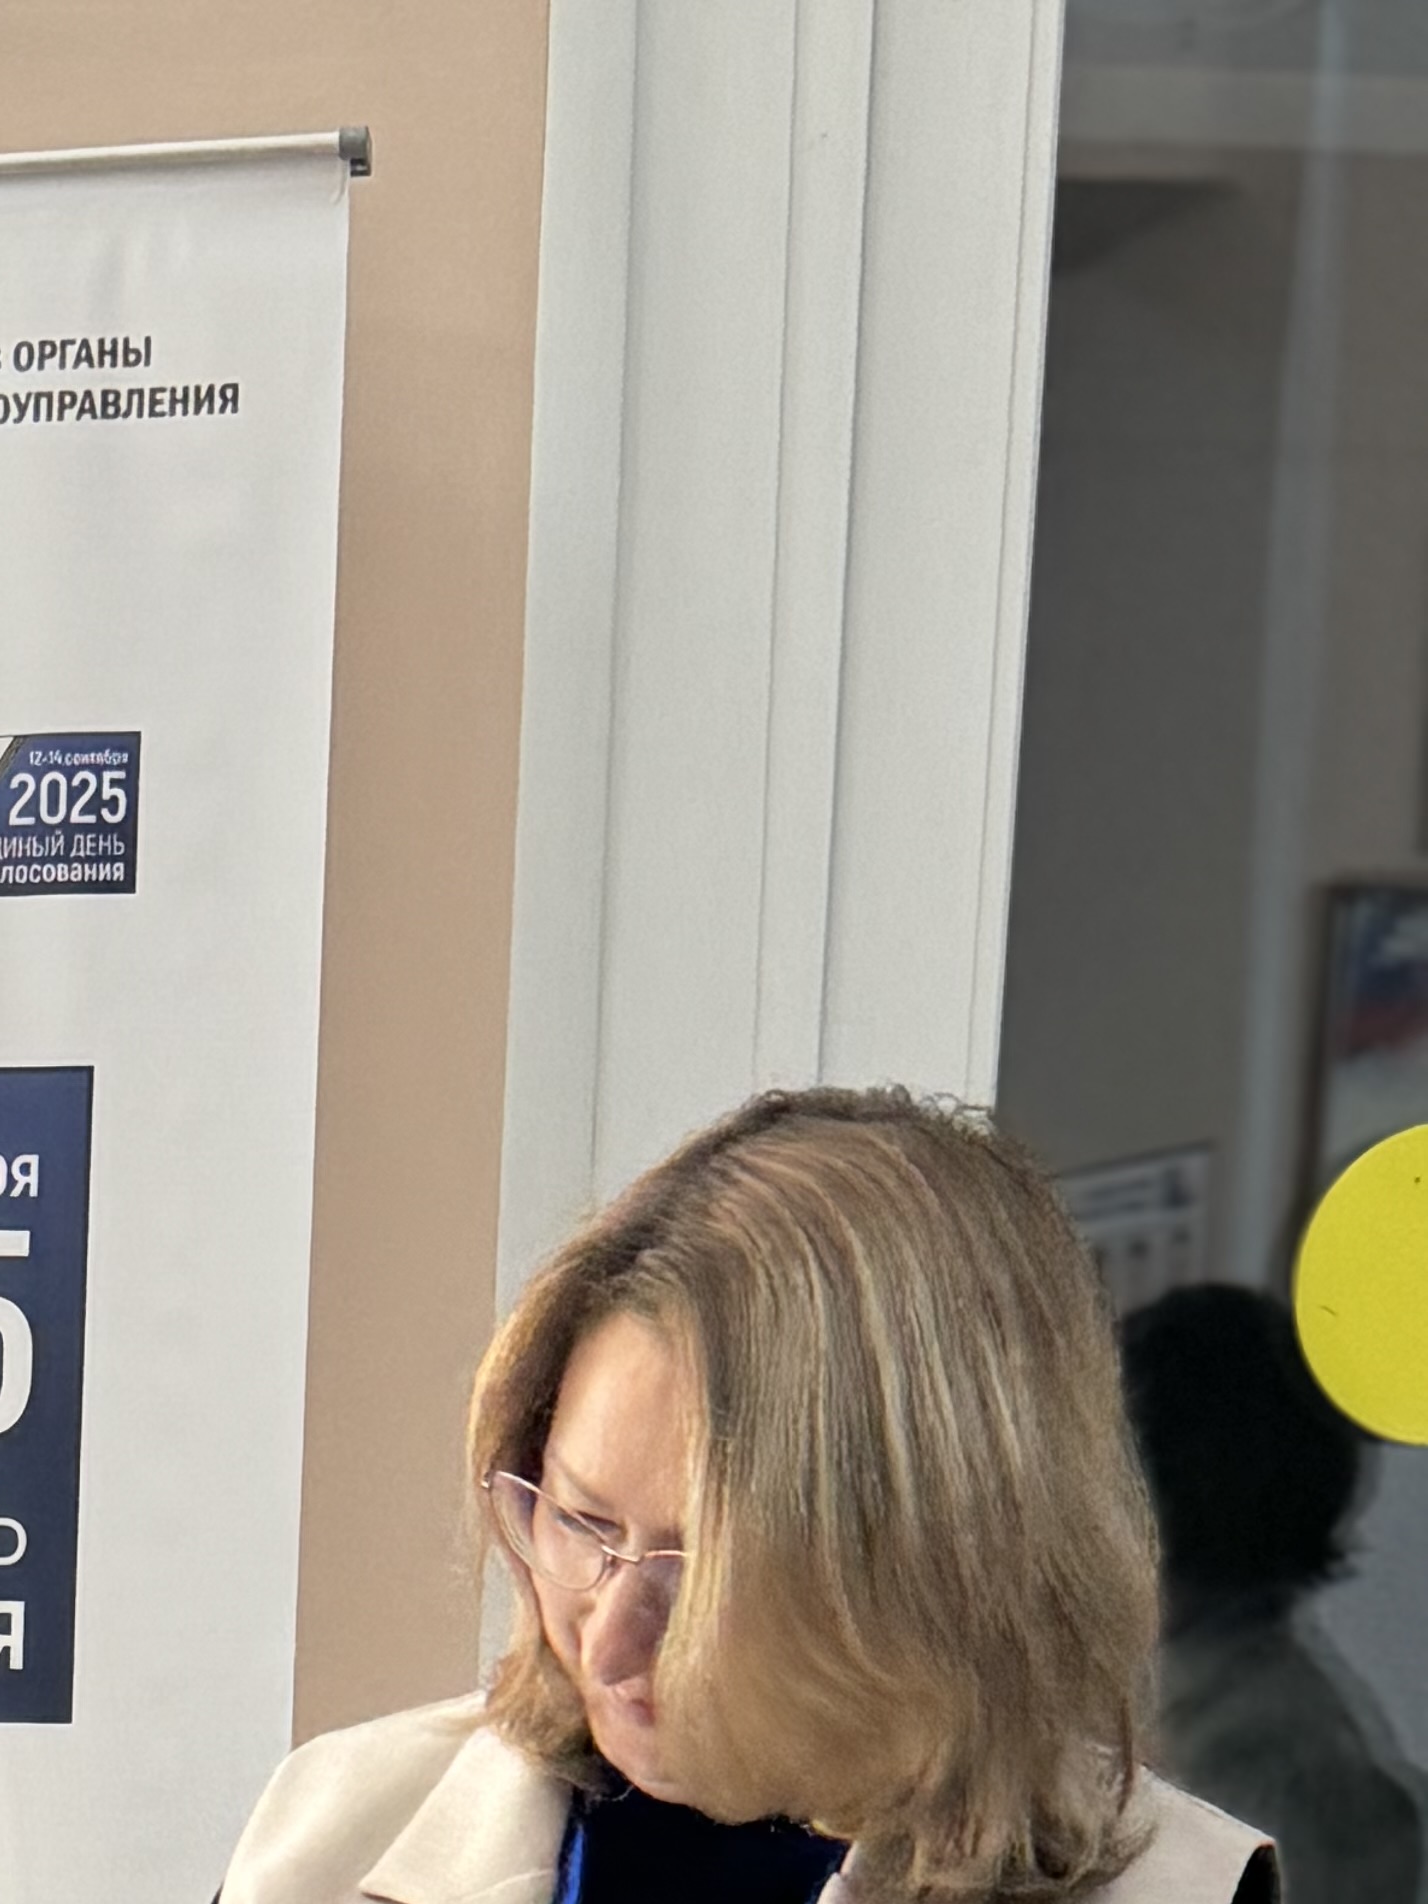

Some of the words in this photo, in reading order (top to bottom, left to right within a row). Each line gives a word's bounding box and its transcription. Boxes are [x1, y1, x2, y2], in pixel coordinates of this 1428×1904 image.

[13, 335, 152, 373] ОРГАНЫ
[9, 771, 127, 826] 2025
[70, 833, 125, 858] ДЕНЬ
